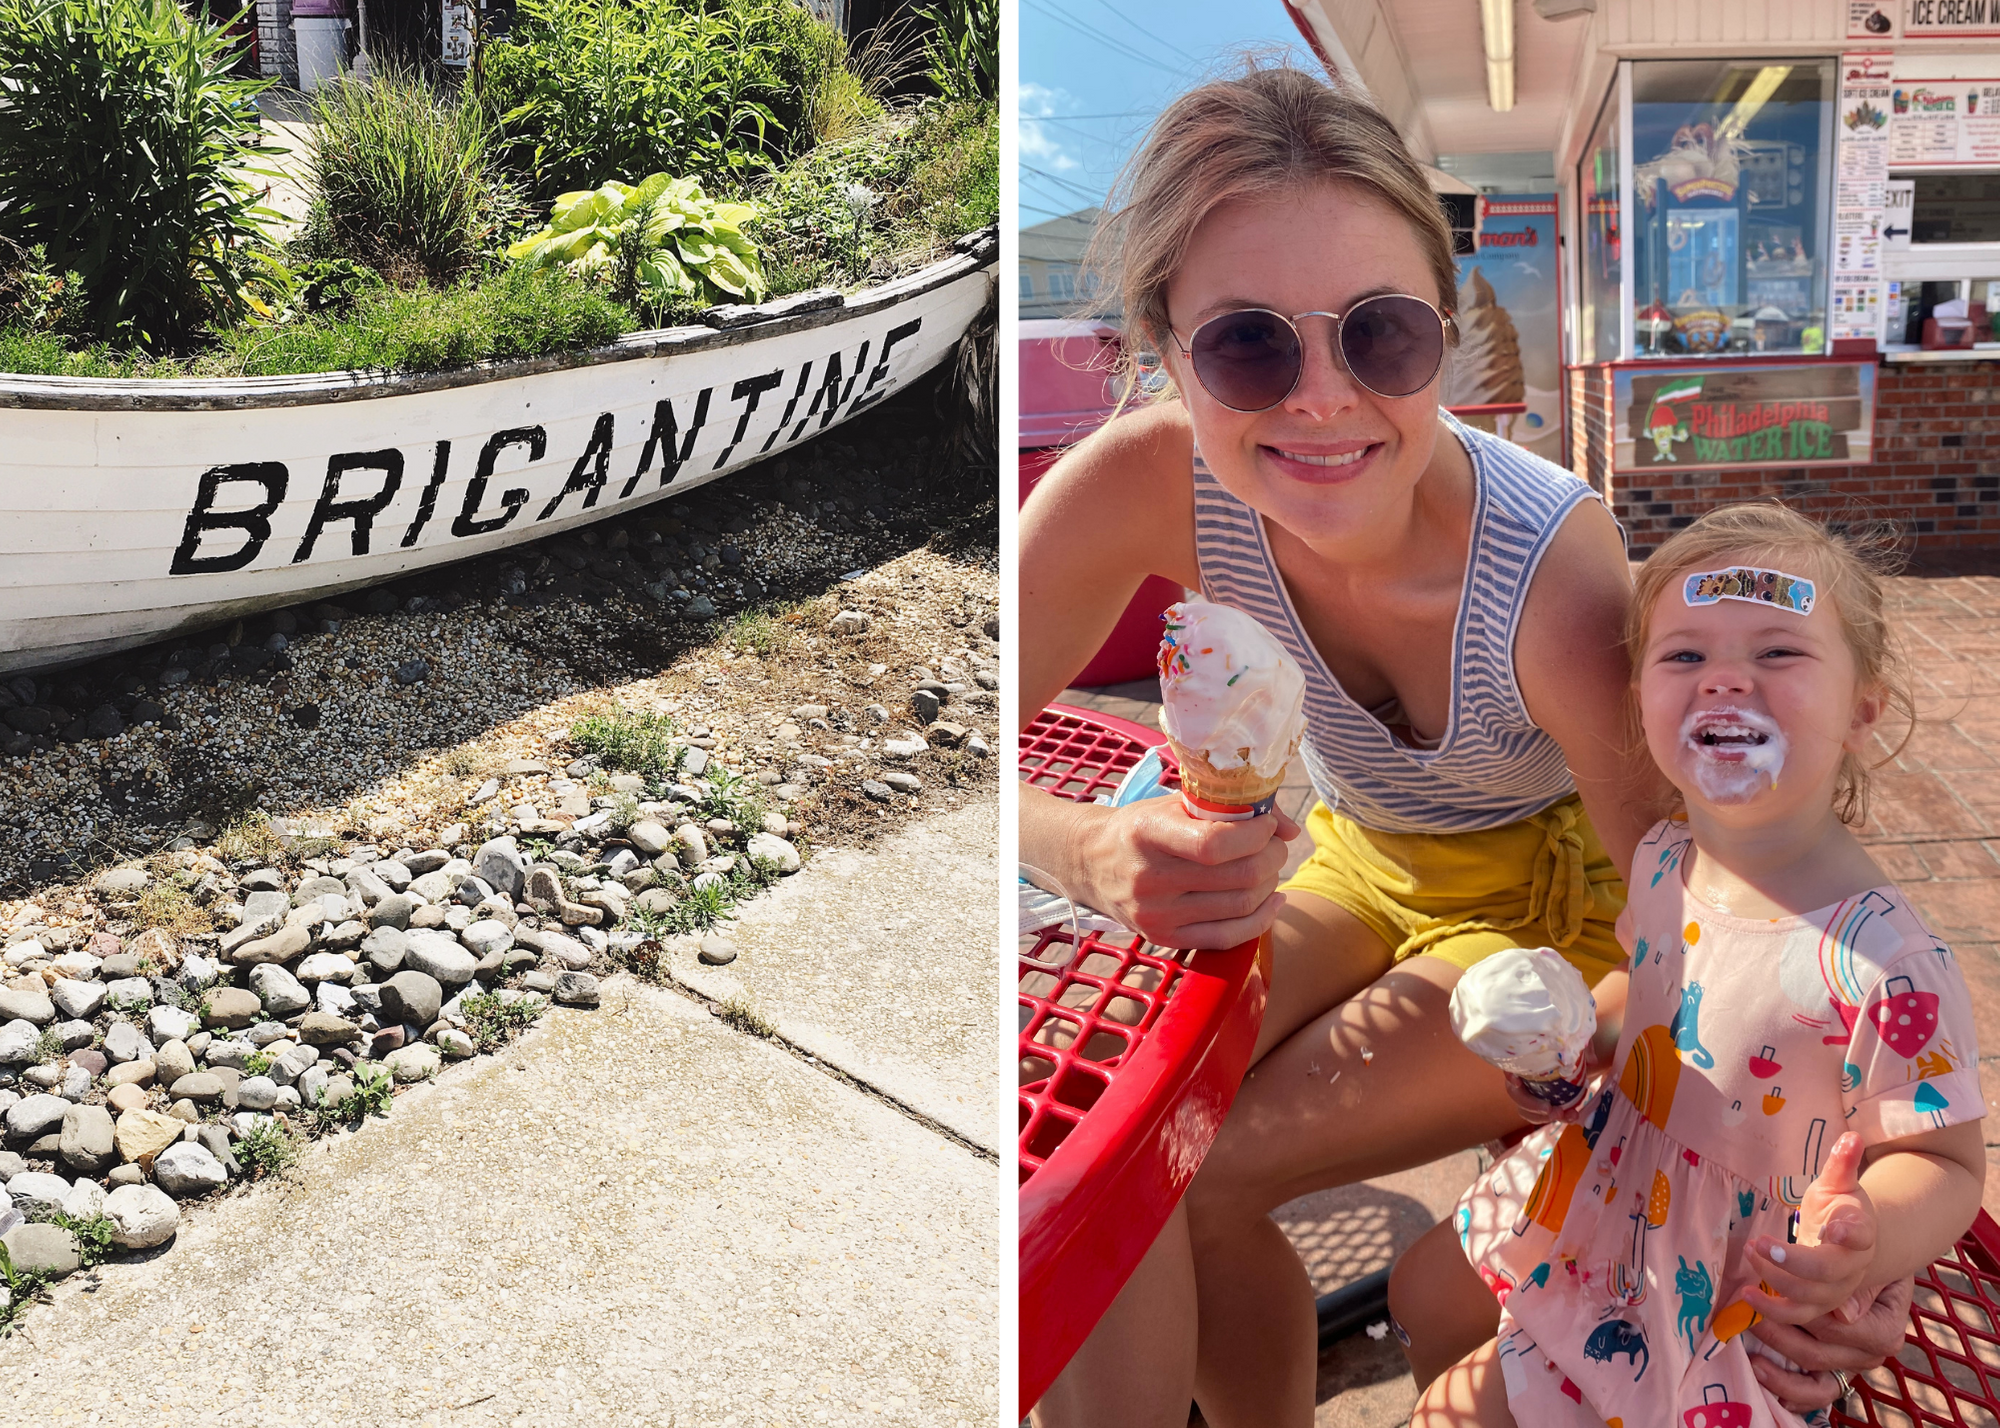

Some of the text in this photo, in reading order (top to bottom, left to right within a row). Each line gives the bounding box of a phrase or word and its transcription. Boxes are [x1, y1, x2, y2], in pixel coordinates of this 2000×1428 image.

[1912, 0, 1935, 25] ICE
[1938, 0, 1986, 25] CREAM
[1479, 225, 1538, 247] man's
[1691, 401, 1830, 438] Philadelphia
[169, 318, 922, 575] BRIGANTINE
[1692, 420, 1834, 461] WATER ICE
